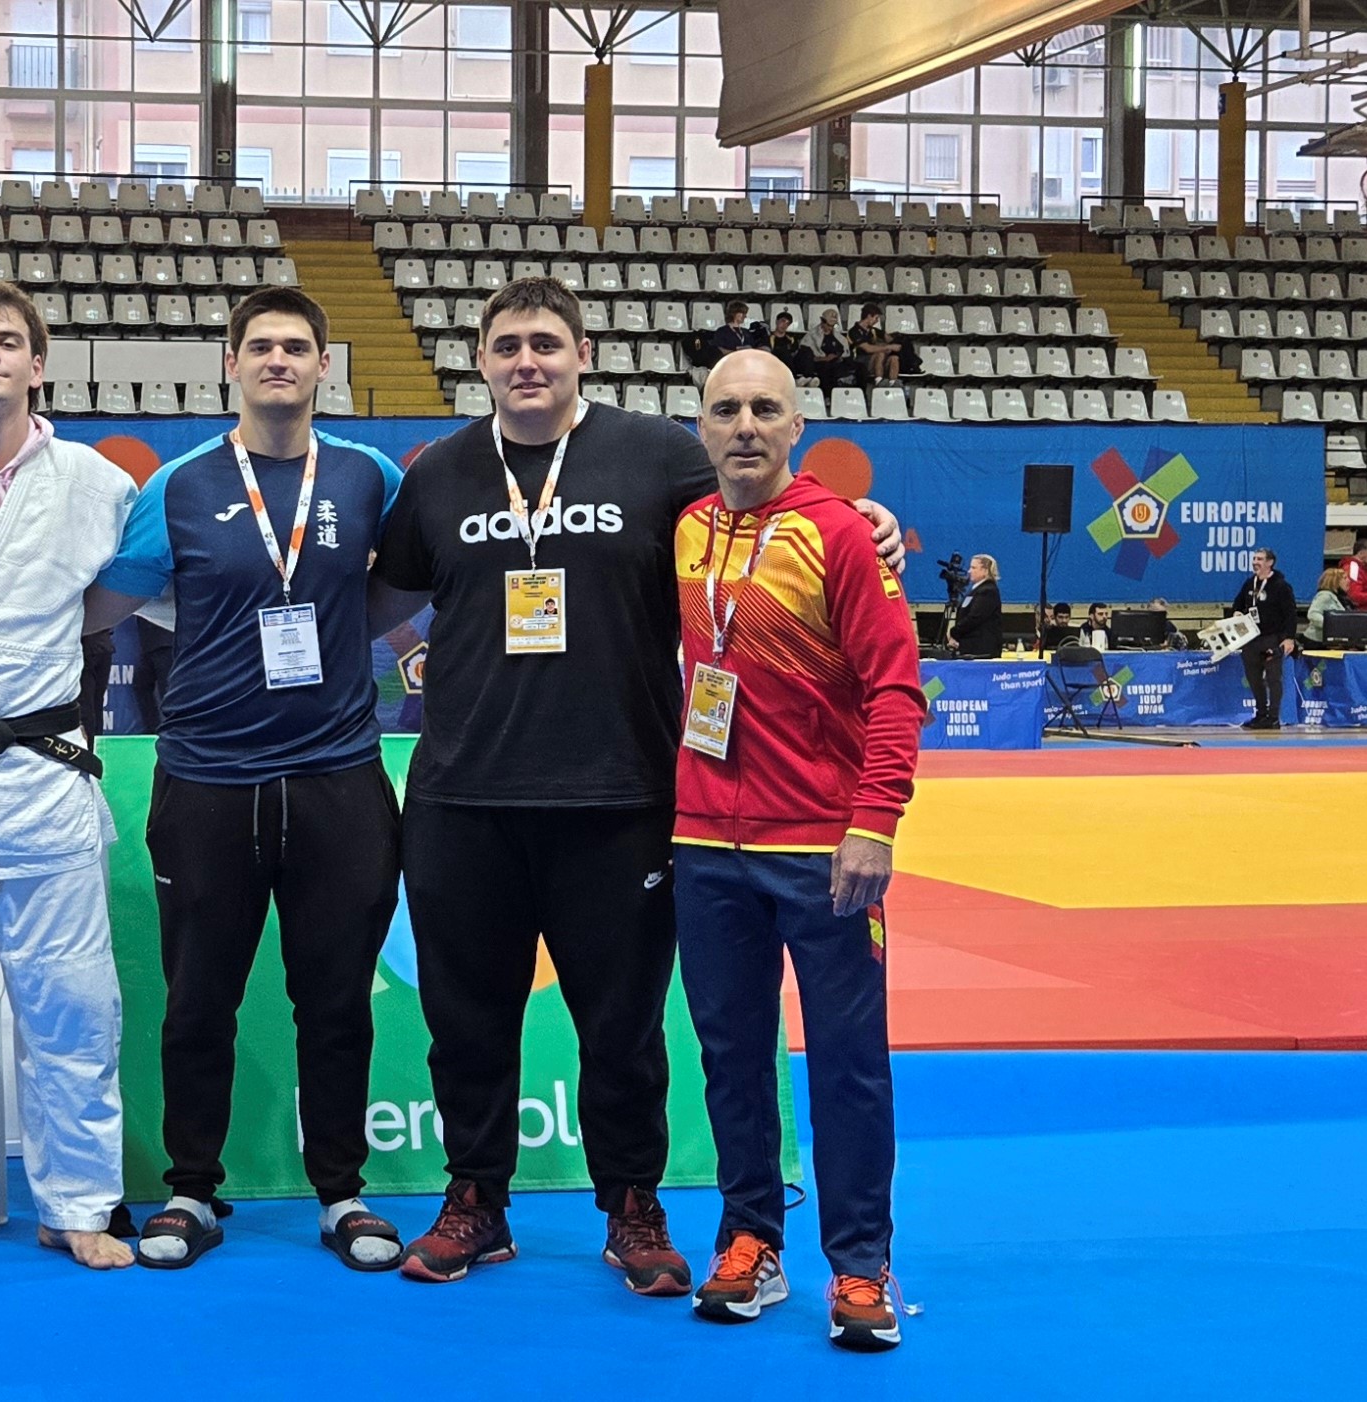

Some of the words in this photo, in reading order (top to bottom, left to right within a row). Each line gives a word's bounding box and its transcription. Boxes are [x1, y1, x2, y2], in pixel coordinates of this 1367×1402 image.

[1180, 501, 1283, 523] EUROPEAN
[316, 499, 340, 549] 柔道
[1206, 526, 1256, 547] JUDO
[992, 673, 1011, 682] Judo
[1018, 670, 1041, 679] more
[1000, 681, 1021, 690] than
[1022, 677, 1045, 689] sport!
[1126, 684, 1173, 695] EUROPEAN
[1139, 694, 1163, 704] JUDO
[936, 700, 988, 712] EUROPEAN
[1137, 704, 1165, 715] UNION
[949, 712, 976, 724] JUDO
[946, 725, 979, 736] UNION
